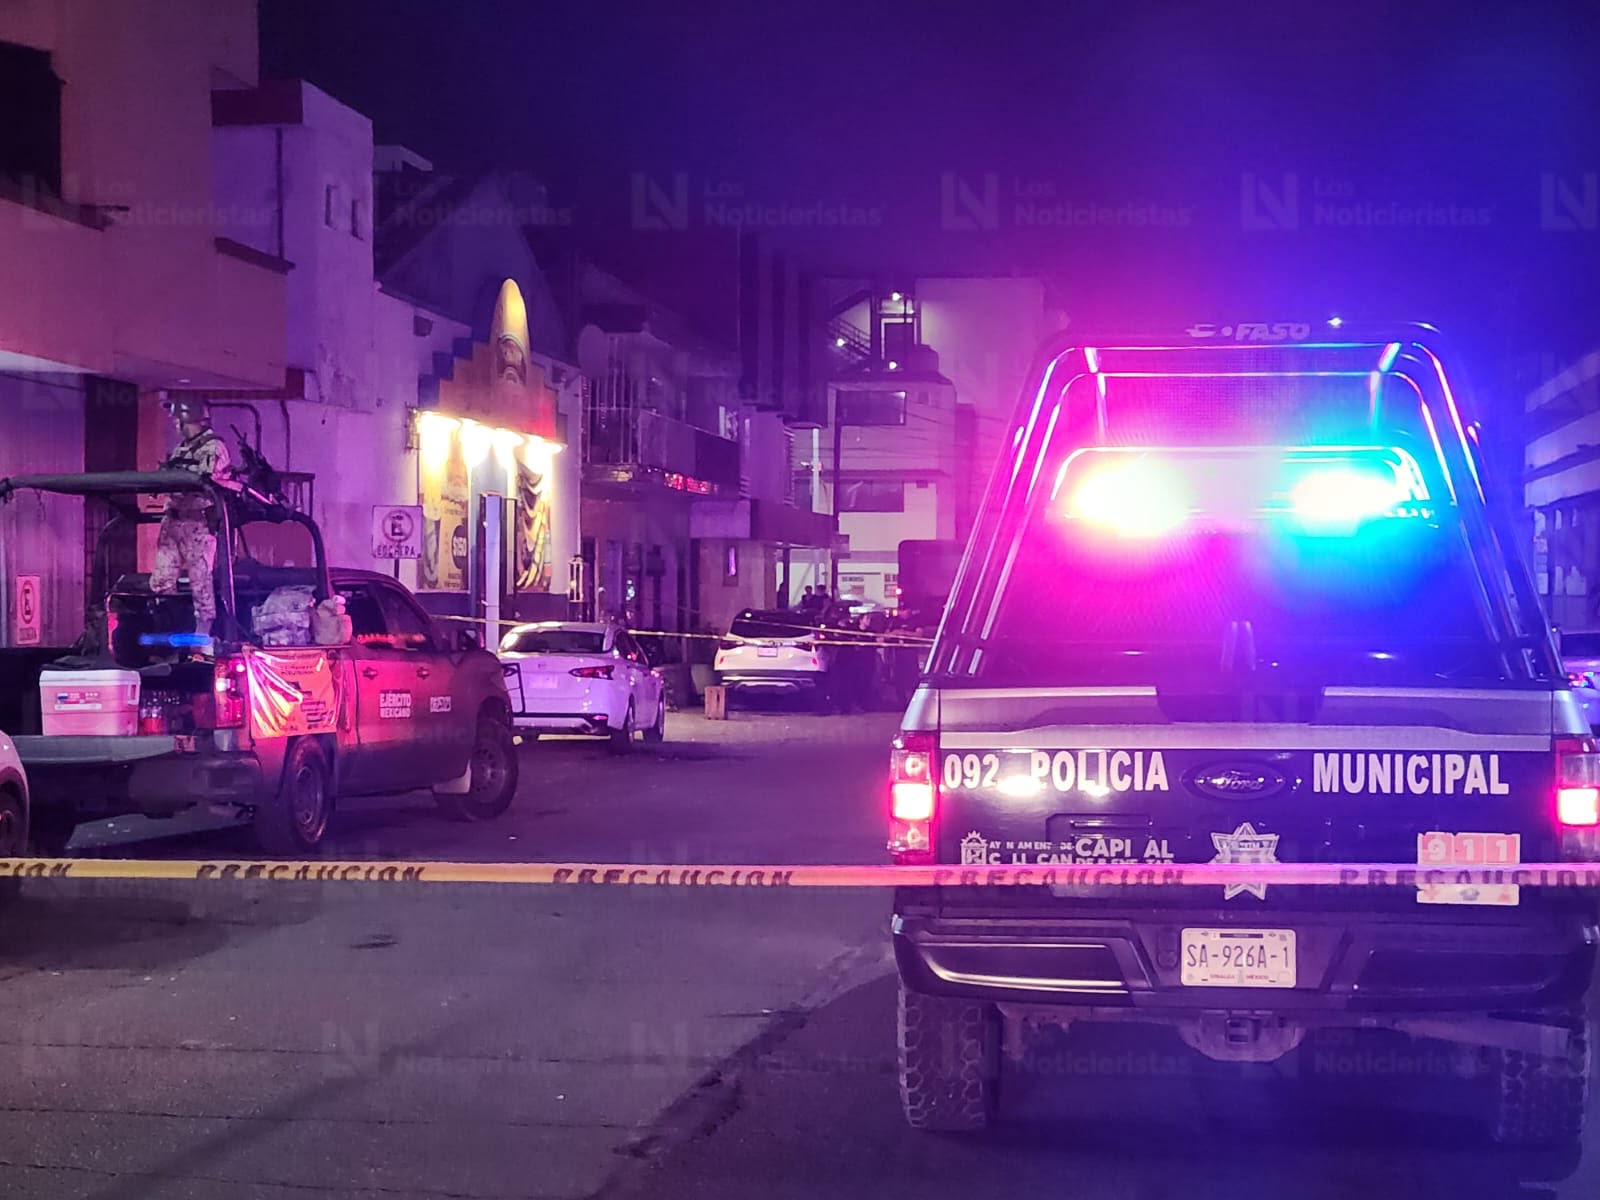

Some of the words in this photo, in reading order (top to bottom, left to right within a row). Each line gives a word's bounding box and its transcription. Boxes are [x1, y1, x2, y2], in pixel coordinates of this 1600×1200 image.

[944, 753, 999, 789] 092
[1030, 751, 1169, 792] POLICIA
[1313, 752, 1509, 795] MUNICIPAL
[1075, 838, 1174, 858] CAPIAL
[1427, 838, 1509, 862] 911
[1186, 943, 1289, 969] SA-926A-1
